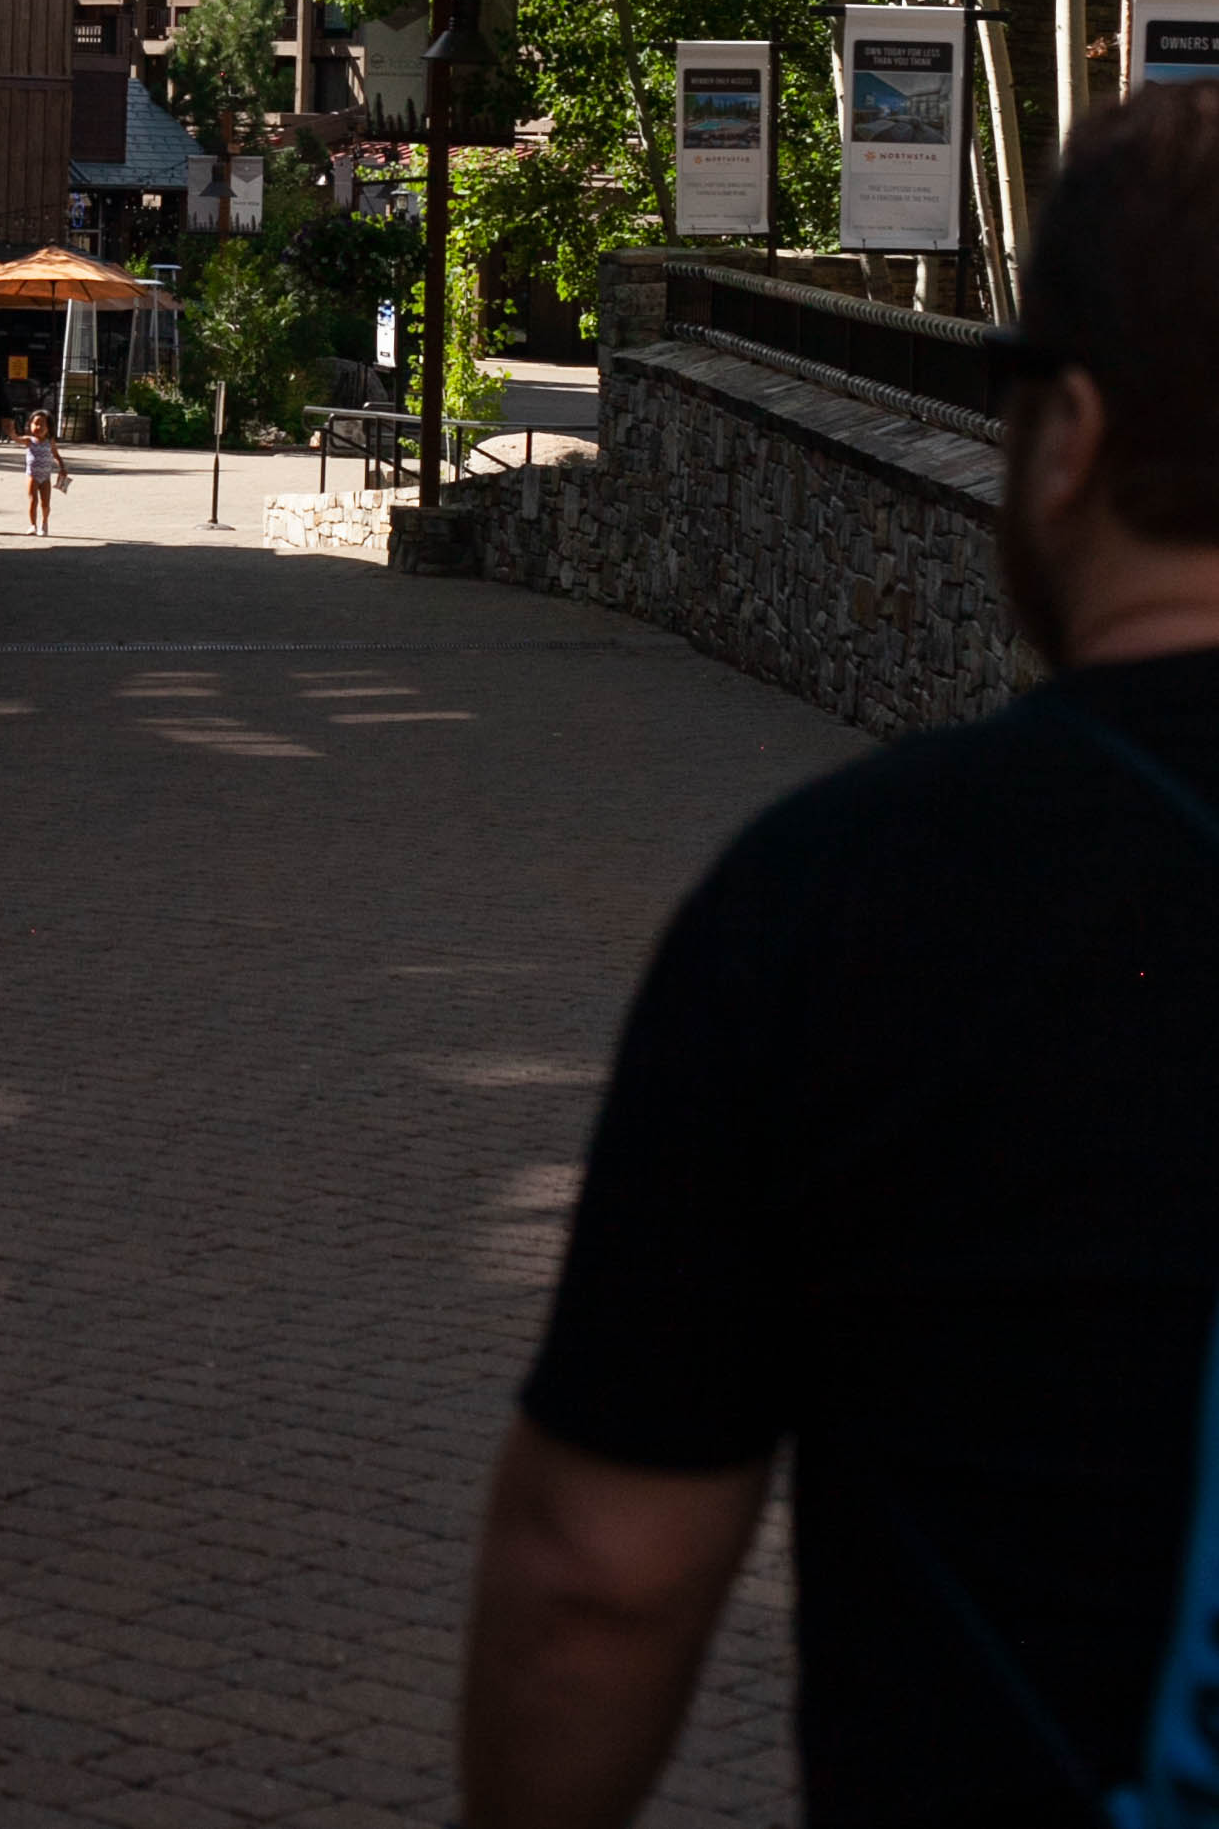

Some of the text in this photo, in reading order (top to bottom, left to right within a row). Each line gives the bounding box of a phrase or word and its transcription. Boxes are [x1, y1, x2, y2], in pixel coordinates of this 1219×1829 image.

[1160, 35, 1210, 51] OWNERS
[884, 46, 906, 57] TODAY
[908, 47, 922, 58] FOR
[924, 48, 941, 59] LESS
[872, 56, 933, 68] THAN YOU THINK
[879, 153, 938, 161] NORTHSTAR
